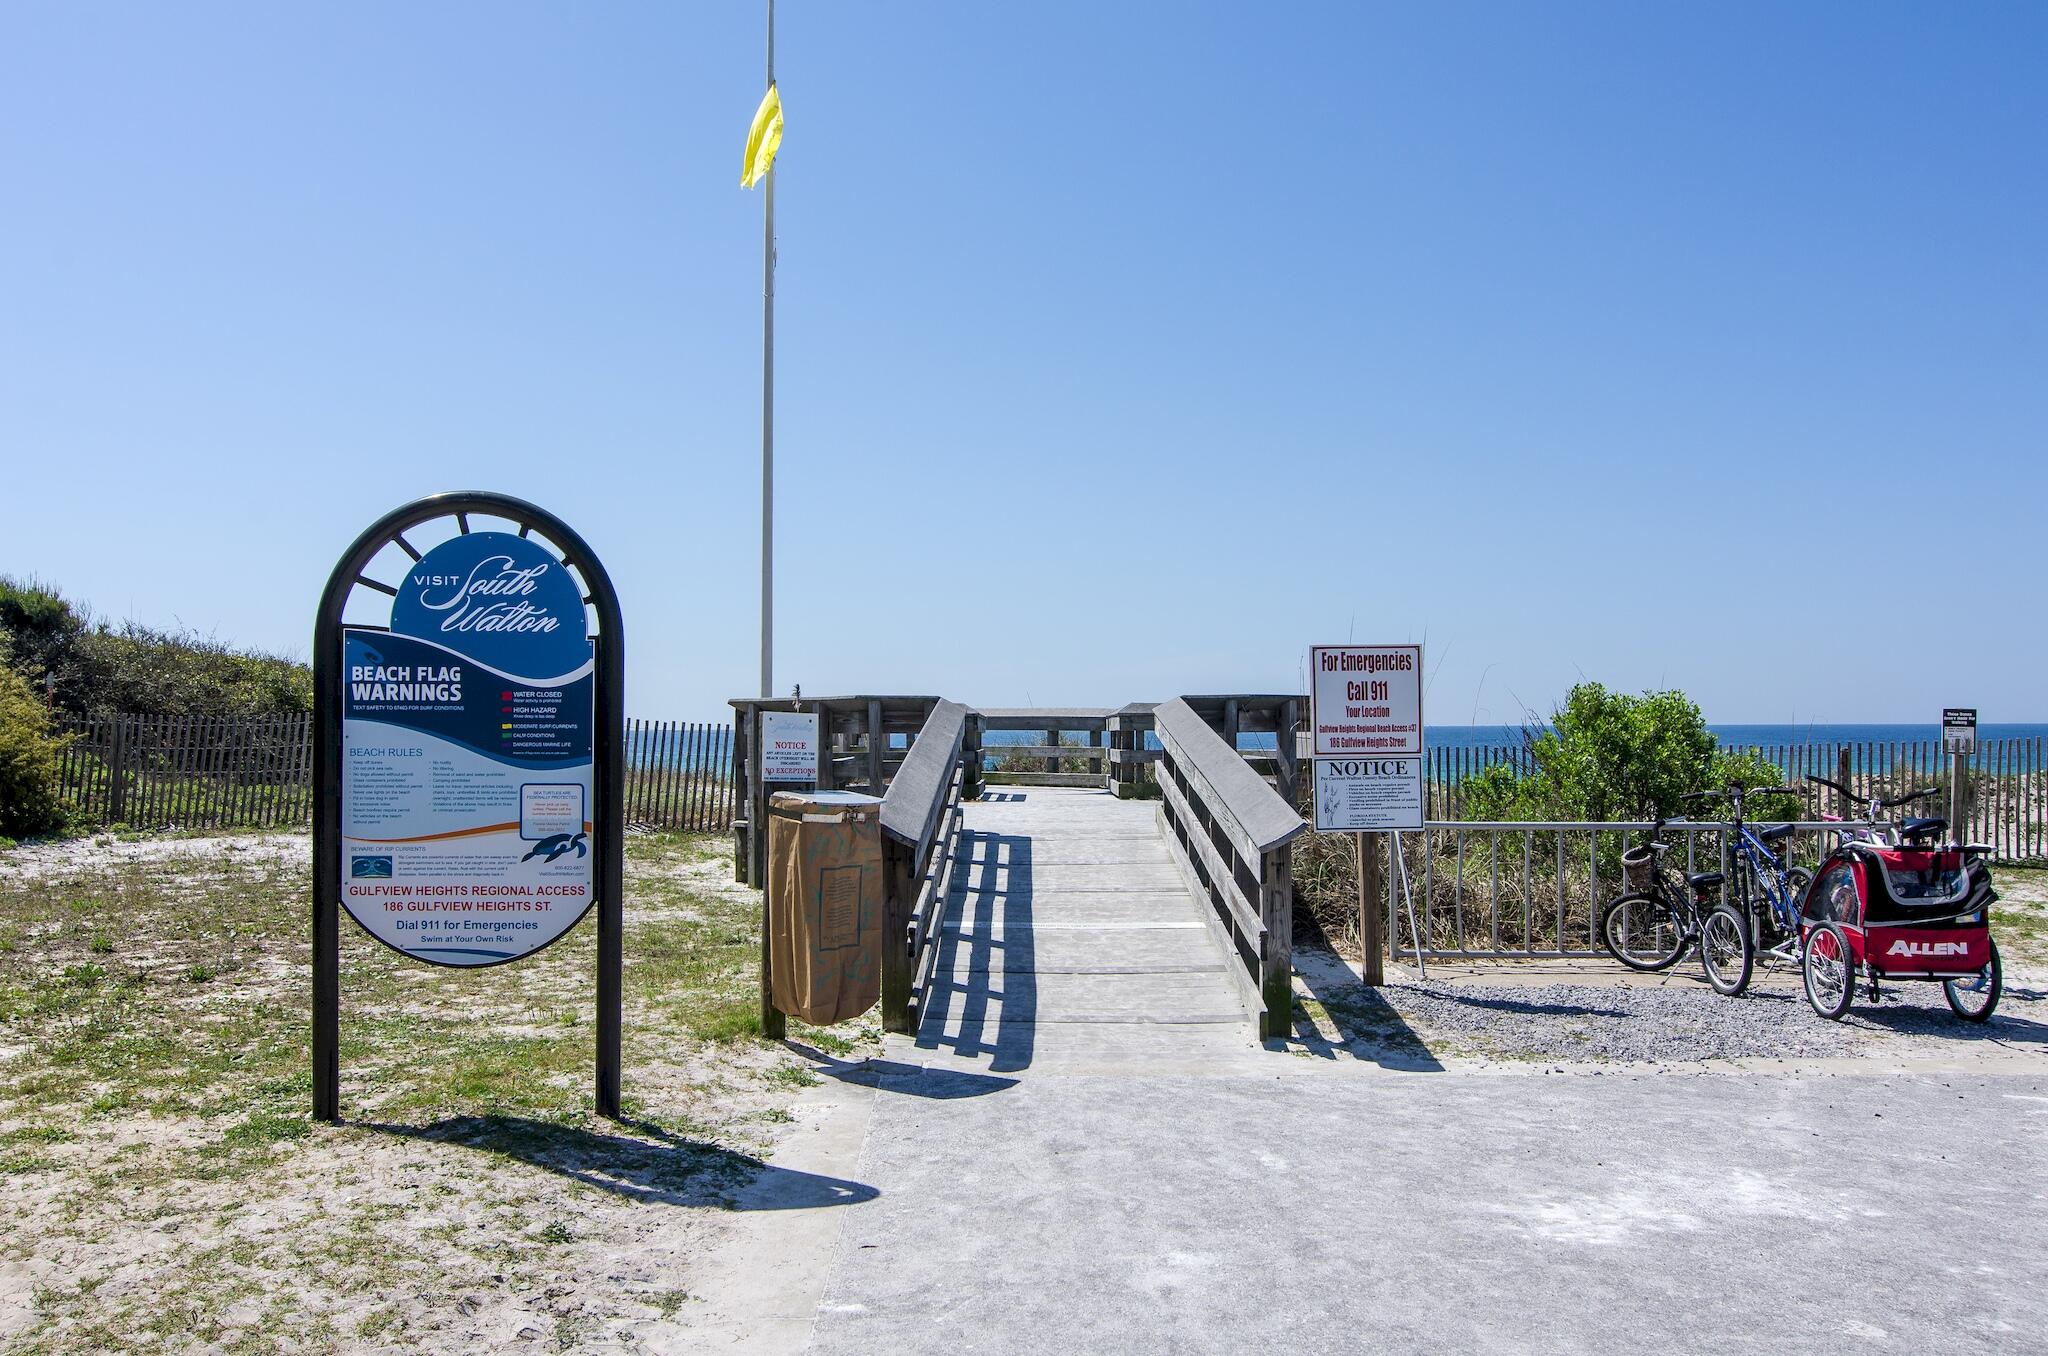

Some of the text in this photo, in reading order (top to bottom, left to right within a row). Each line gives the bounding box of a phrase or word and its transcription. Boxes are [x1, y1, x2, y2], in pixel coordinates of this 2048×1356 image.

[414, 555, 548, 610] VISIT South
[440, 595, 560, 633] Walton
[1322, 651, 1412, 673] For Emergencies
[352, 666, 461, 682] BEACH FLAG
[352, 683, 462, 701] WARNINGS
[1347, 681, 1388, 701] Call 911
[1346, 705, 1390, 718] Your Location
[1339, 724, 1356, 734] Heights
[1357, 724, 1377, 733] Regional
[1377, 724, 1391, 732] Beach
[1391, 723, 1408, 732] Access
[775, 741, 807, 750] NOTICE
[1341, 737, 1366, 748] Gulfview
[1366, 737, 1389, 749] Heights
[1389, 736, 1407, 747] Street
[349, 748, 423, 757] BEACH RULES
[1329, 760, 1408, 776] NOTICE
[350, 886, 585, 896] GULFVIEW HEIGHTS REGIONAL ACCESS
[383, 901, 552, 911] 186 GULFVIEW HEIGHTS ST.
[396, 920, 538, 932] Dial 911 for Emergencies
[421, 935, 514, 943] Swim at Your Own Risk
[1886, 940, 1968, 957] ALLEN
